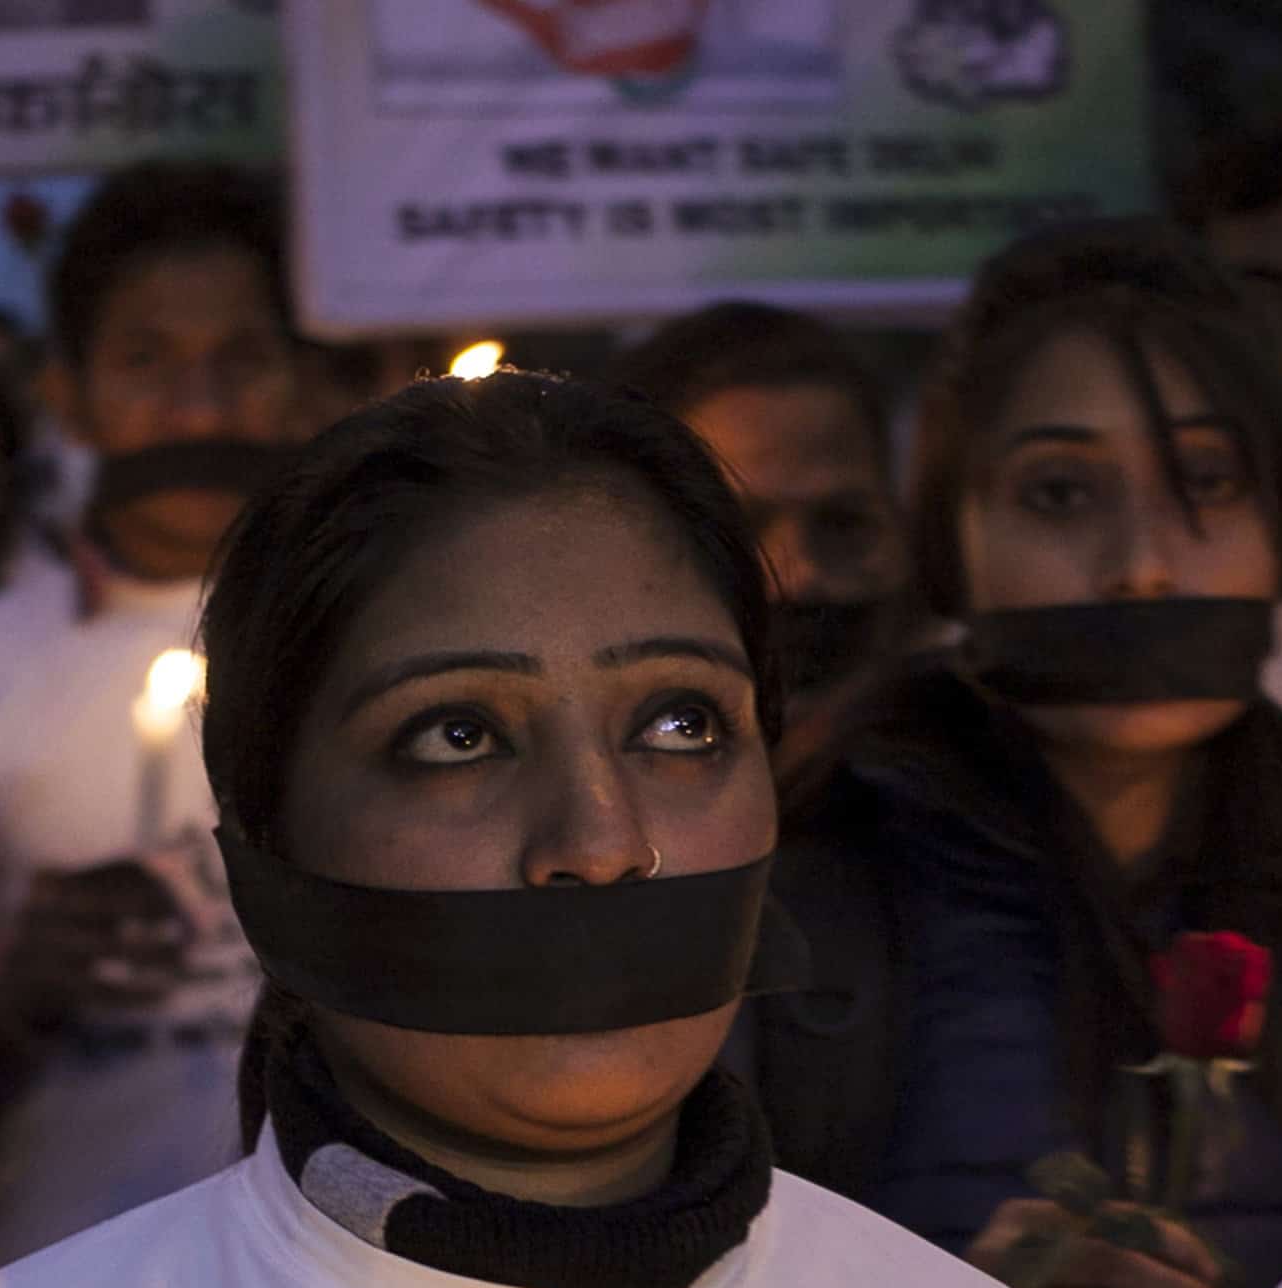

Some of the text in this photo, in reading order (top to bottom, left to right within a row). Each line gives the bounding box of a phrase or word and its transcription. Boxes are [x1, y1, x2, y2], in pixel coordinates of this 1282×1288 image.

[503, 140, 573, 178] WE
[588, 138, 718, 175] WANT
[738, 136, 854, 175] SAFE
[396, 203, 586, 242] SAFETY
[608, 201, 656, 239] IS
[673, 199, 805, 236] MOST
